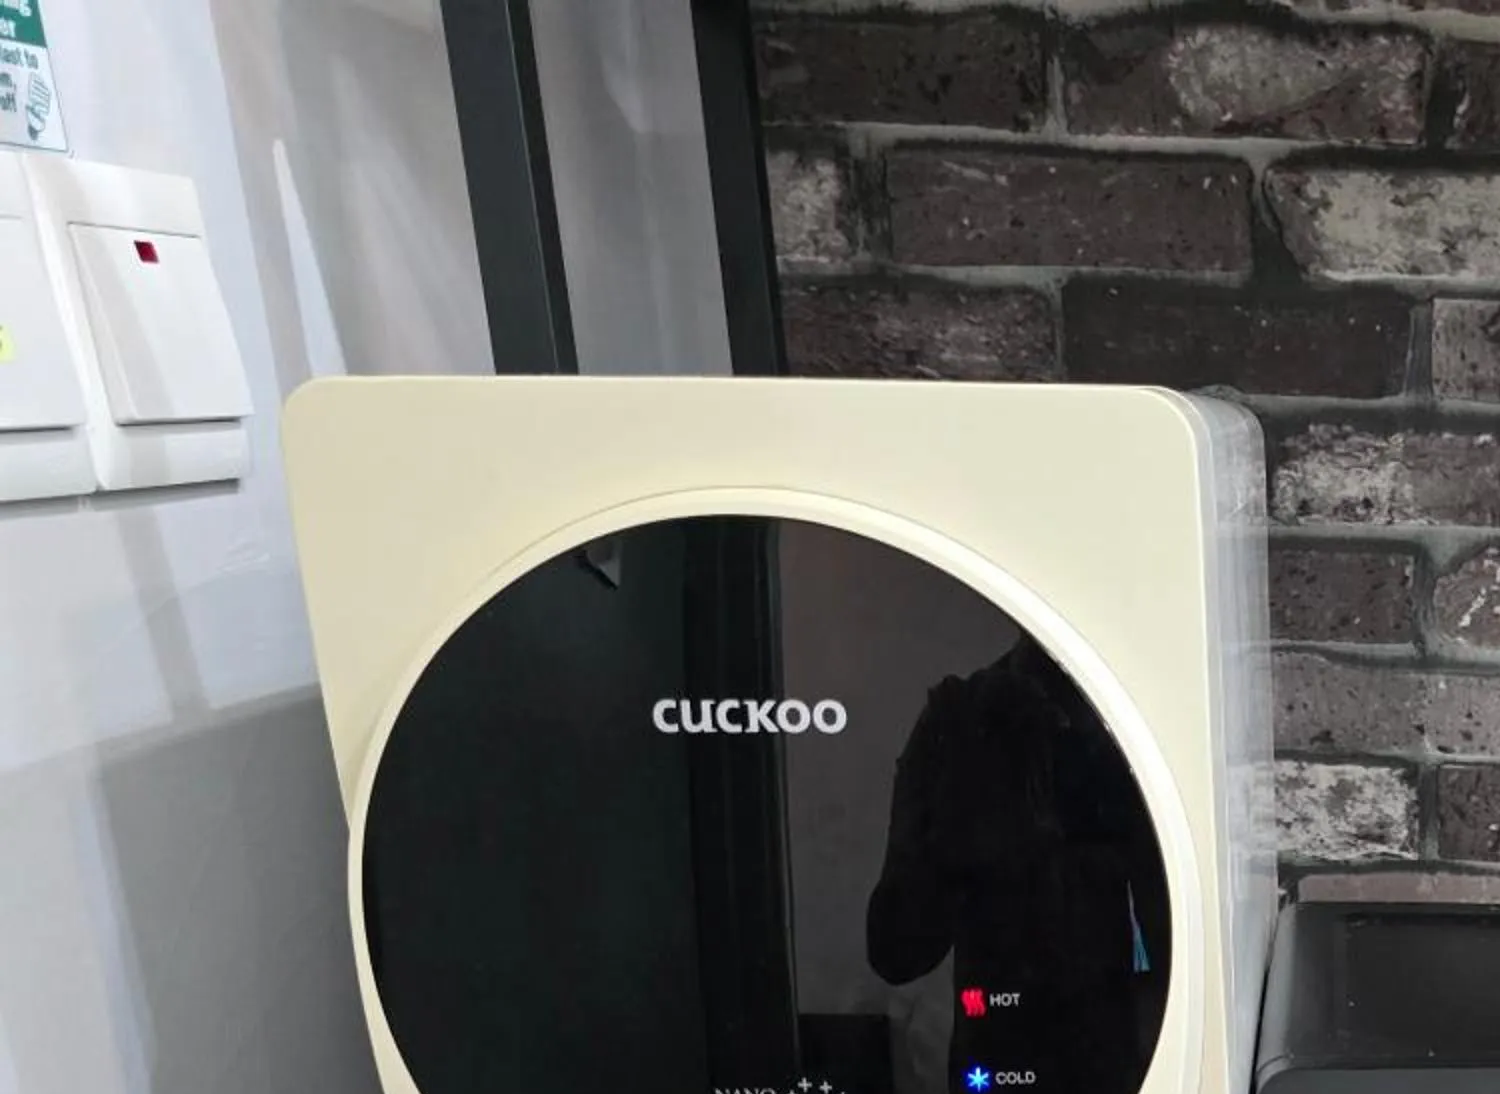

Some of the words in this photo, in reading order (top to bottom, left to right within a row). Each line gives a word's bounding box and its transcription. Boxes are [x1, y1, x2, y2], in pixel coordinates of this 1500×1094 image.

[652, 699, 848, 734] CUCKOO
[989, 993, 1020, 1007] HOT
[995, 1071, 1036, 1085] COLD
